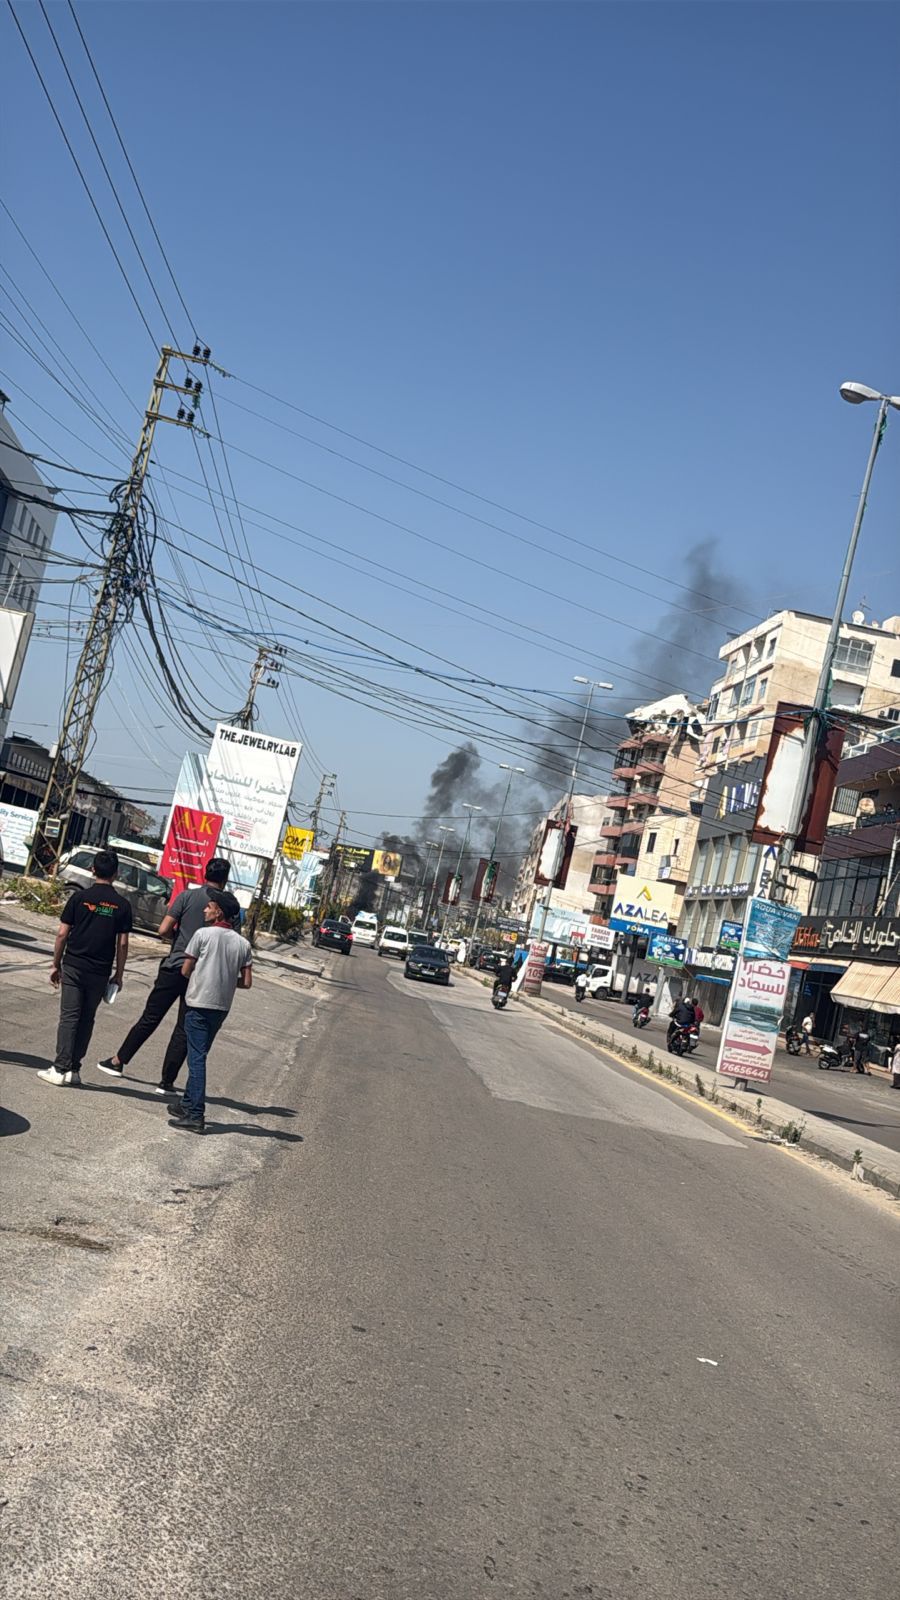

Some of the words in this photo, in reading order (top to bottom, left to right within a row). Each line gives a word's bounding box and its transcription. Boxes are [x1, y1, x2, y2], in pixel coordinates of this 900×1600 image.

[220, 728, 297, 758] THE.JEWELRY.LAB
[614, 902, 668, 922] AZALEA
[743, 960, 786, 980] خضرا
[738, 977, 785, 996] للسجاد
[722, 1062, 770, 1080] 76656441
